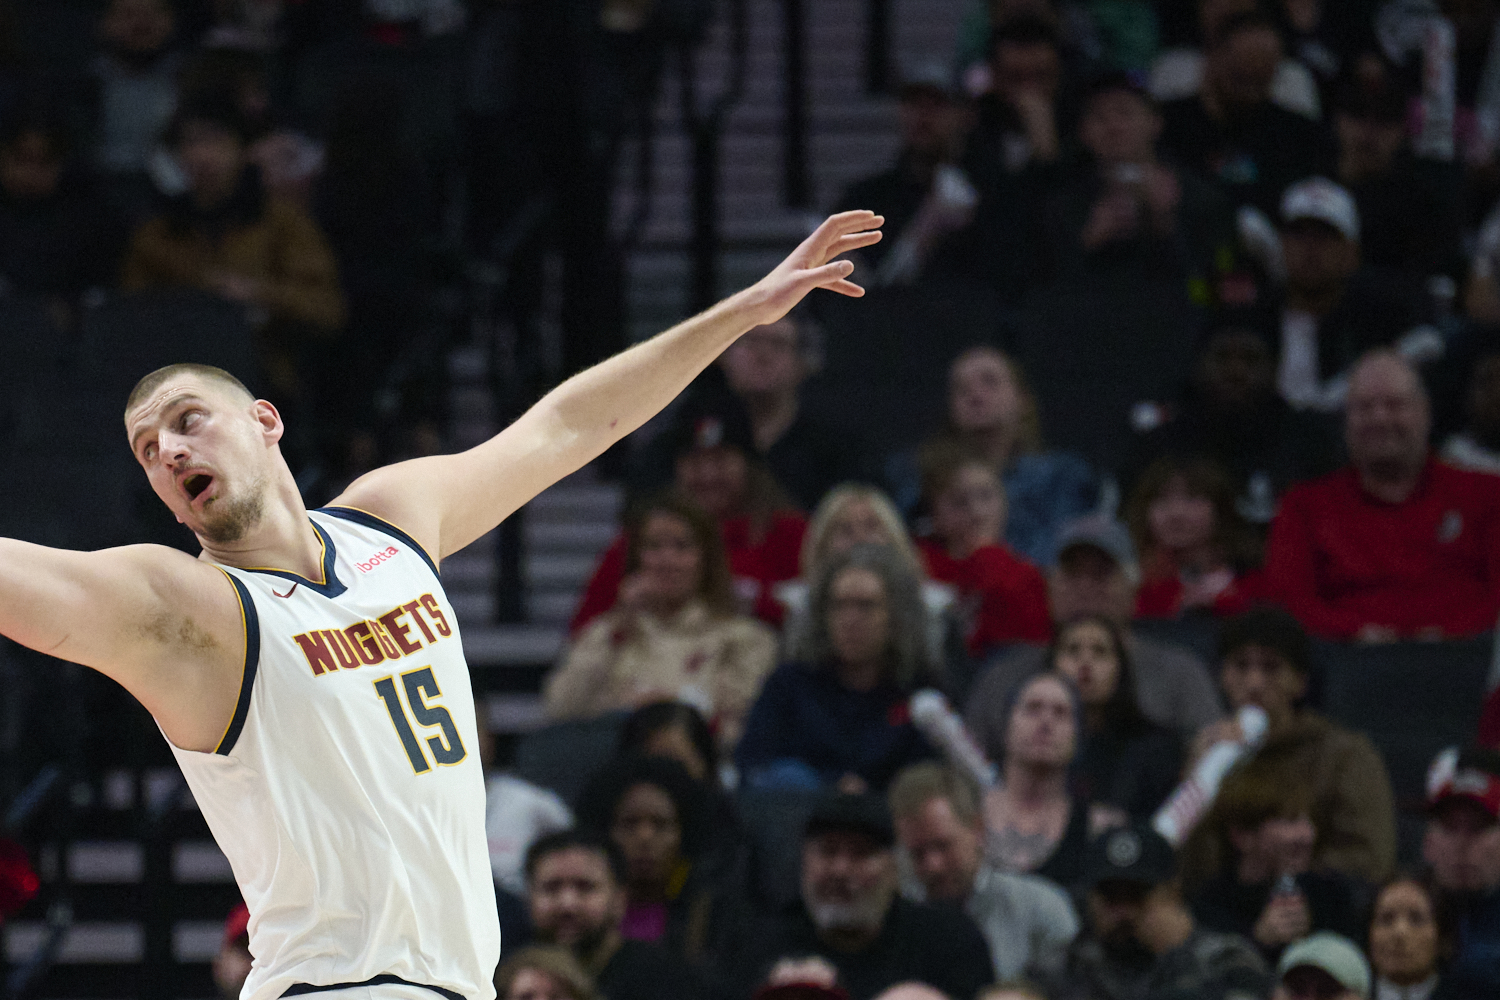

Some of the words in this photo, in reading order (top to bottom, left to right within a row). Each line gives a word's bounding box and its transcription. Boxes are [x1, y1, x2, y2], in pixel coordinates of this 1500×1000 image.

[353, 545, 399, 574] ibotta
[292, 592, 452, 678] NUGGETS
[371, 664, 469, 776] 15
